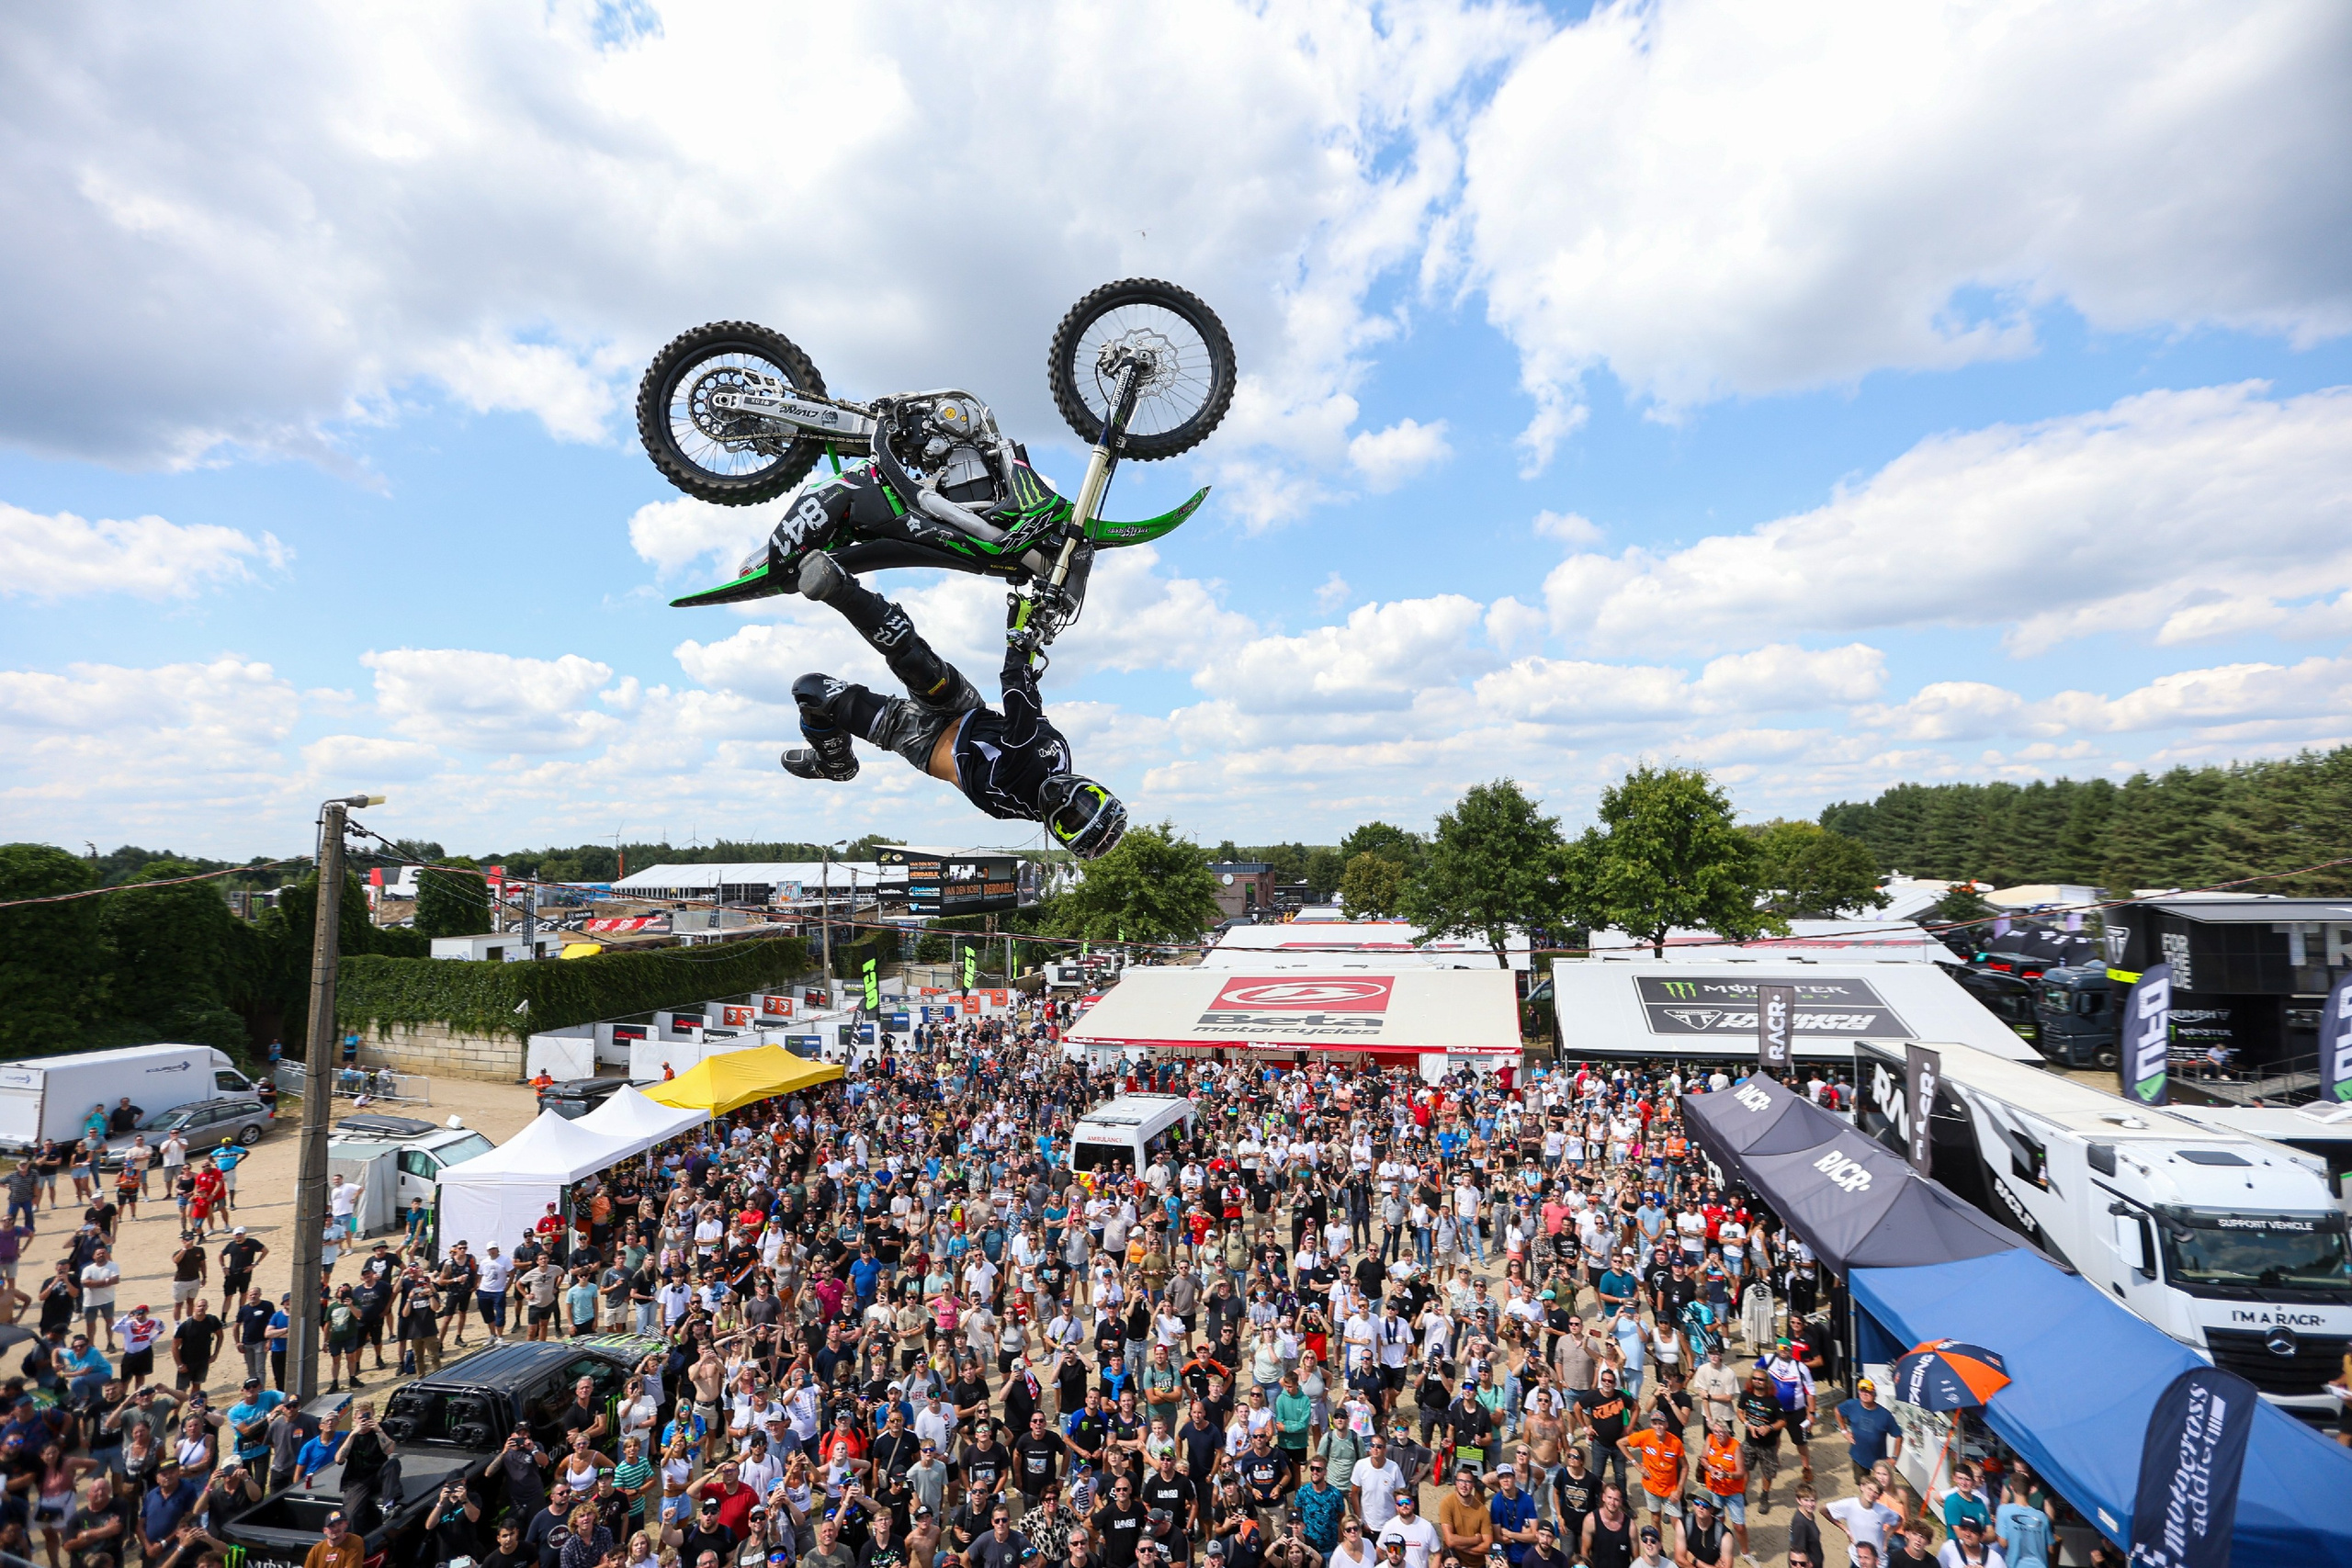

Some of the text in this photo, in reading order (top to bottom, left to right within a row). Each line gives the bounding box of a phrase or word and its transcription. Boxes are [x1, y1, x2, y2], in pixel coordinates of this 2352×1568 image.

[1111, 367, 1129, 407] COMMENCAL
[772, 497, 829, 557] 841
[983, 882, 1015, 896] DERDAELE
[1197, 1013, 1384, 1027] Beta
[1192, 1025, 1381, 1036] motorcycles
[1445, 1045, 1479, 1054] Beta
[1086, 1135, 1124, 1144] AMBULANCE
[2217, 1218, 2315, 1231] SUPPORT VEHICLE
[2232, 1310, 2256, 1324] I'M
[2259, 1312, 2271, 1325] A
[1592, 1399, 1625, 1419] KTM
[2164, 1382, 2209, 1558] motocross
